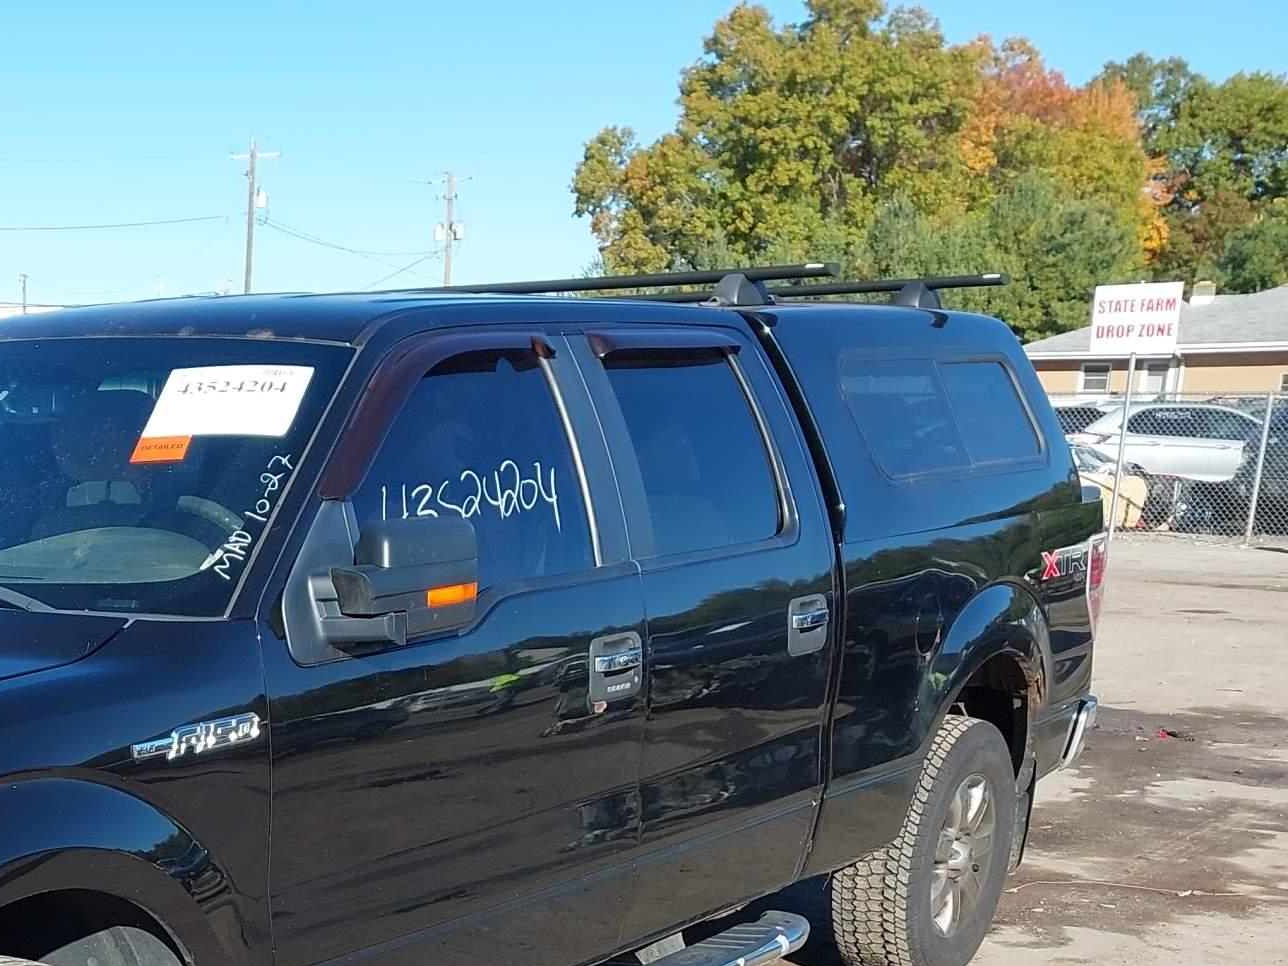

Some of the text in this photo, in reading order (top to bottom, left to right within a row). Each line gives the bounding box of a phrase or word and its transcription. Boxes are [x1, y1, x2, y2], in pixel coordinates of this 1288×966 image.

[1098, 297, 1177, 314] STATE FARM
[1095, 322, 1174, 339] DROP ZONE
[177, 380, 288, 396] 43524204
[140, 443, 185, 451] DETAILED
[213, 530, 252, 580] MAD
